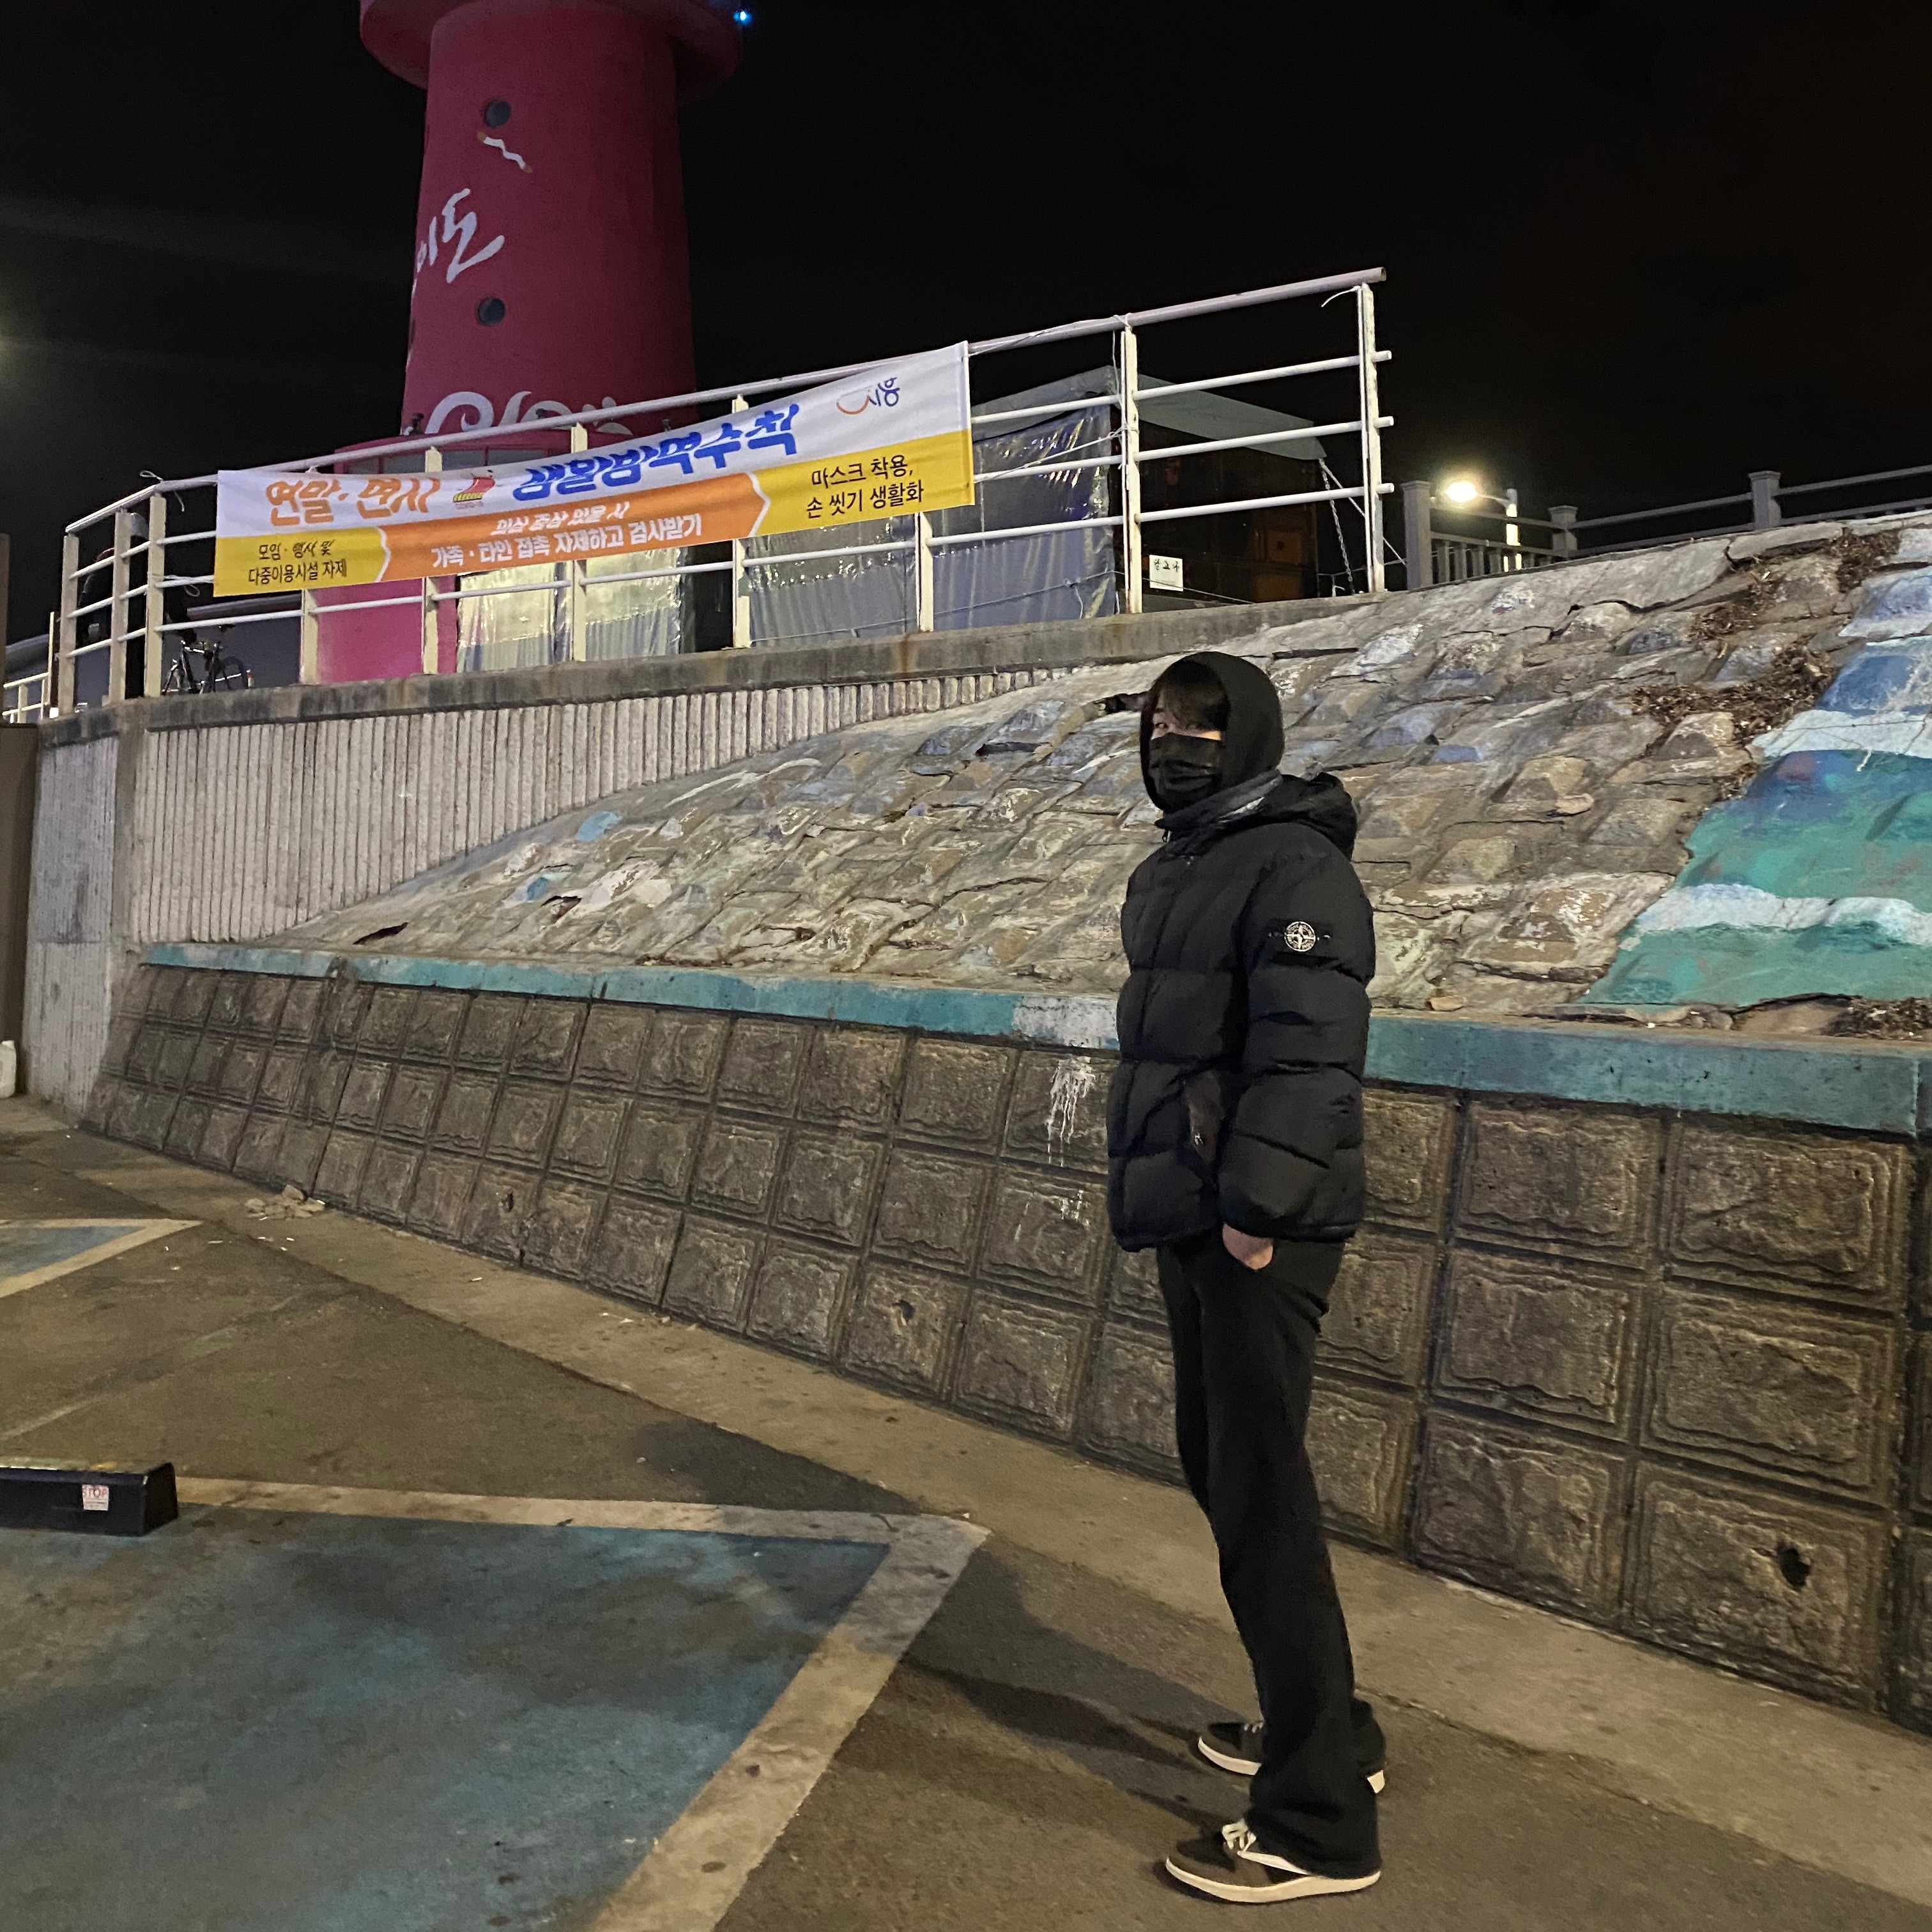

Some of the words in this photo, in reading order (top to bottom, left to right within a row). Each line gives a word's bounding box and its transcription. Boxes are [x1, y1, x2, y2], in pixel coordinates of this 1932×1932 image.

[811, 463, 866, 489] 마스크
[806, 496, 824, 519] 손
[829, 489, 862, 516] 씻기
[870, 479, 924, 509] 생활화
[477, 540, 512, 564] 타인
[516, 536, 551, 559] 접촉
[553, 525, 624, 554] 자제하고
[629, 513, 702, 544] 검사받기
[248, 563, 319, 586] 다중이용시설
[322, 558, 348, 579] 자제
